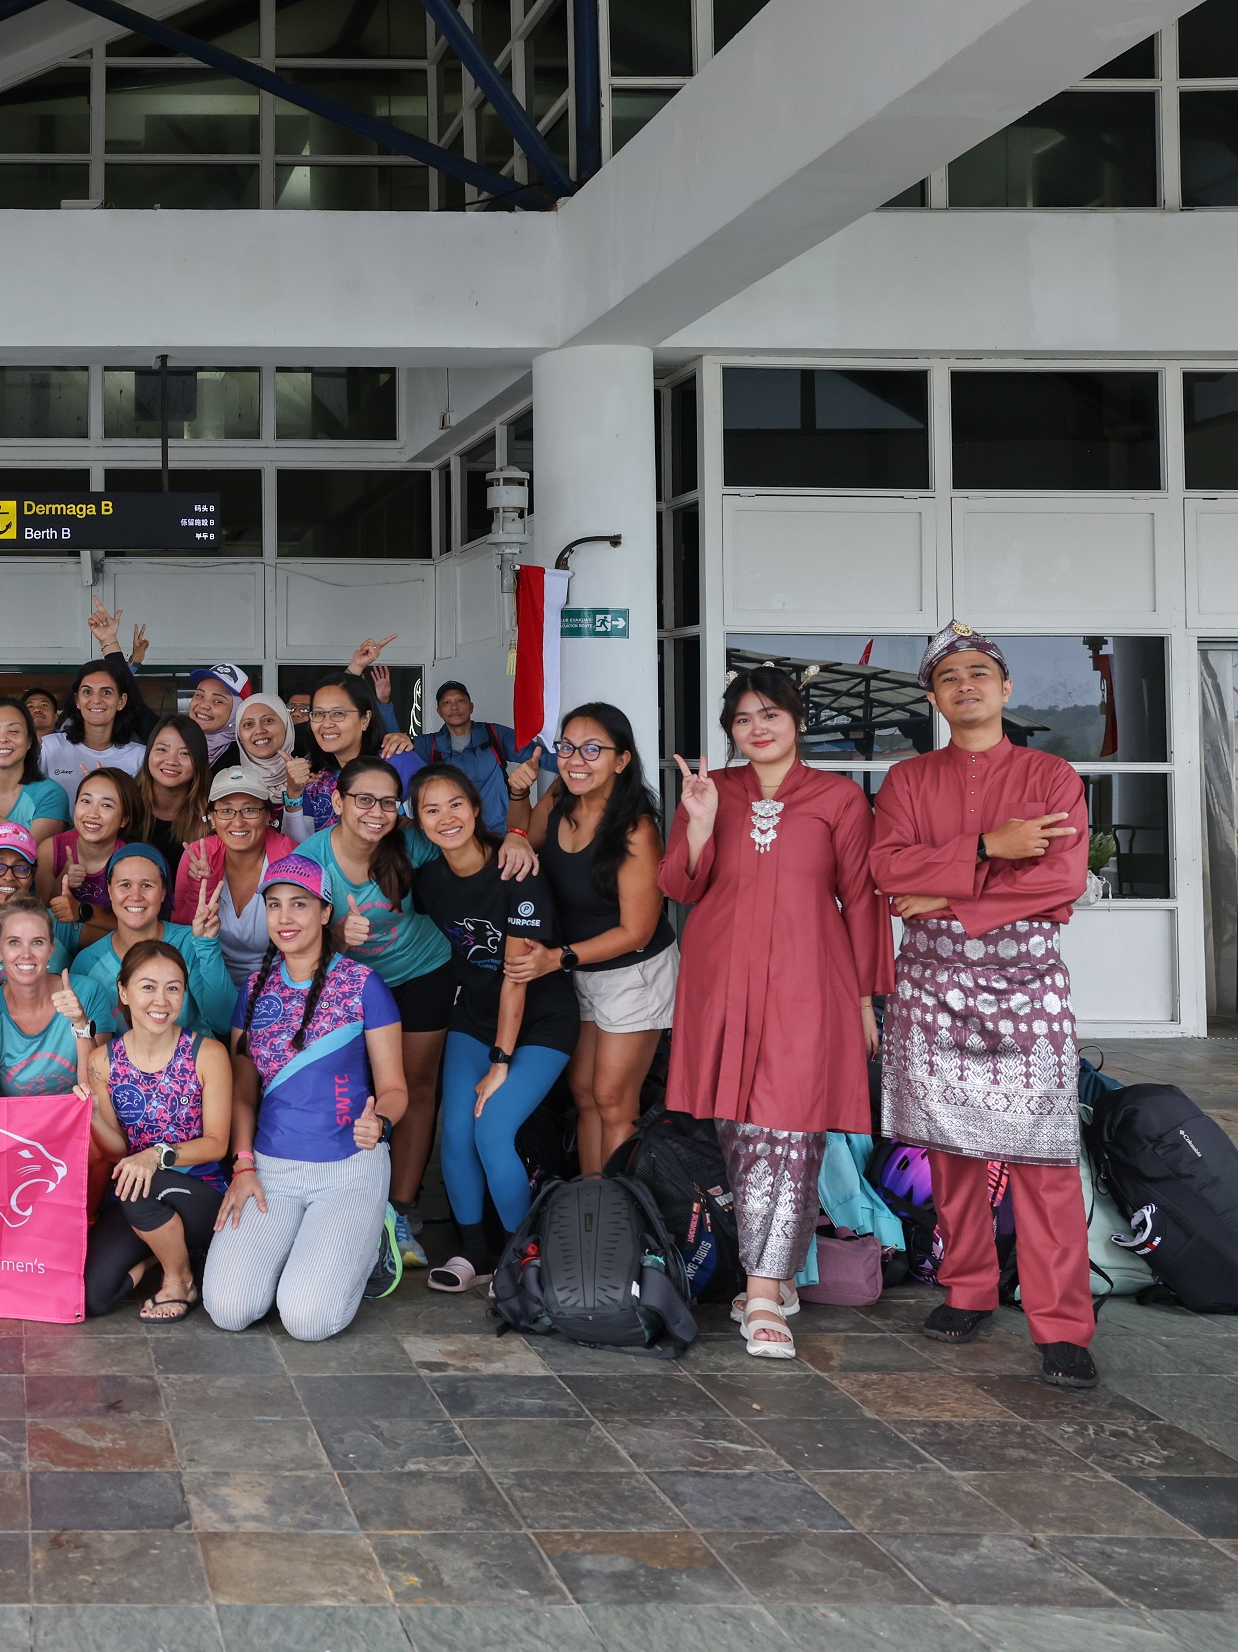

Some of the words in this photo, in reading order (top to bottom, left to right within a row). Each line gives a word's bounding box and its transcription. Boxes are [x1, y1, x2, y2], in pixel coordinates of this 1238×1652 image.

[23, 501, 97, 518] Dermaga
[101, 501, 113, 515] B
[24, 528, 58, 540] Berth
[61, 528, 71, 539] B
[507, 917, 541, 927] PURPOSE
[334, 1073, 353, 1126] SWTC
[1183, 1134, 1202, 1158] Columbia
[692, 1240, 712, 1265] SUBIC
[686, 1261, 699, 1280] BAY
